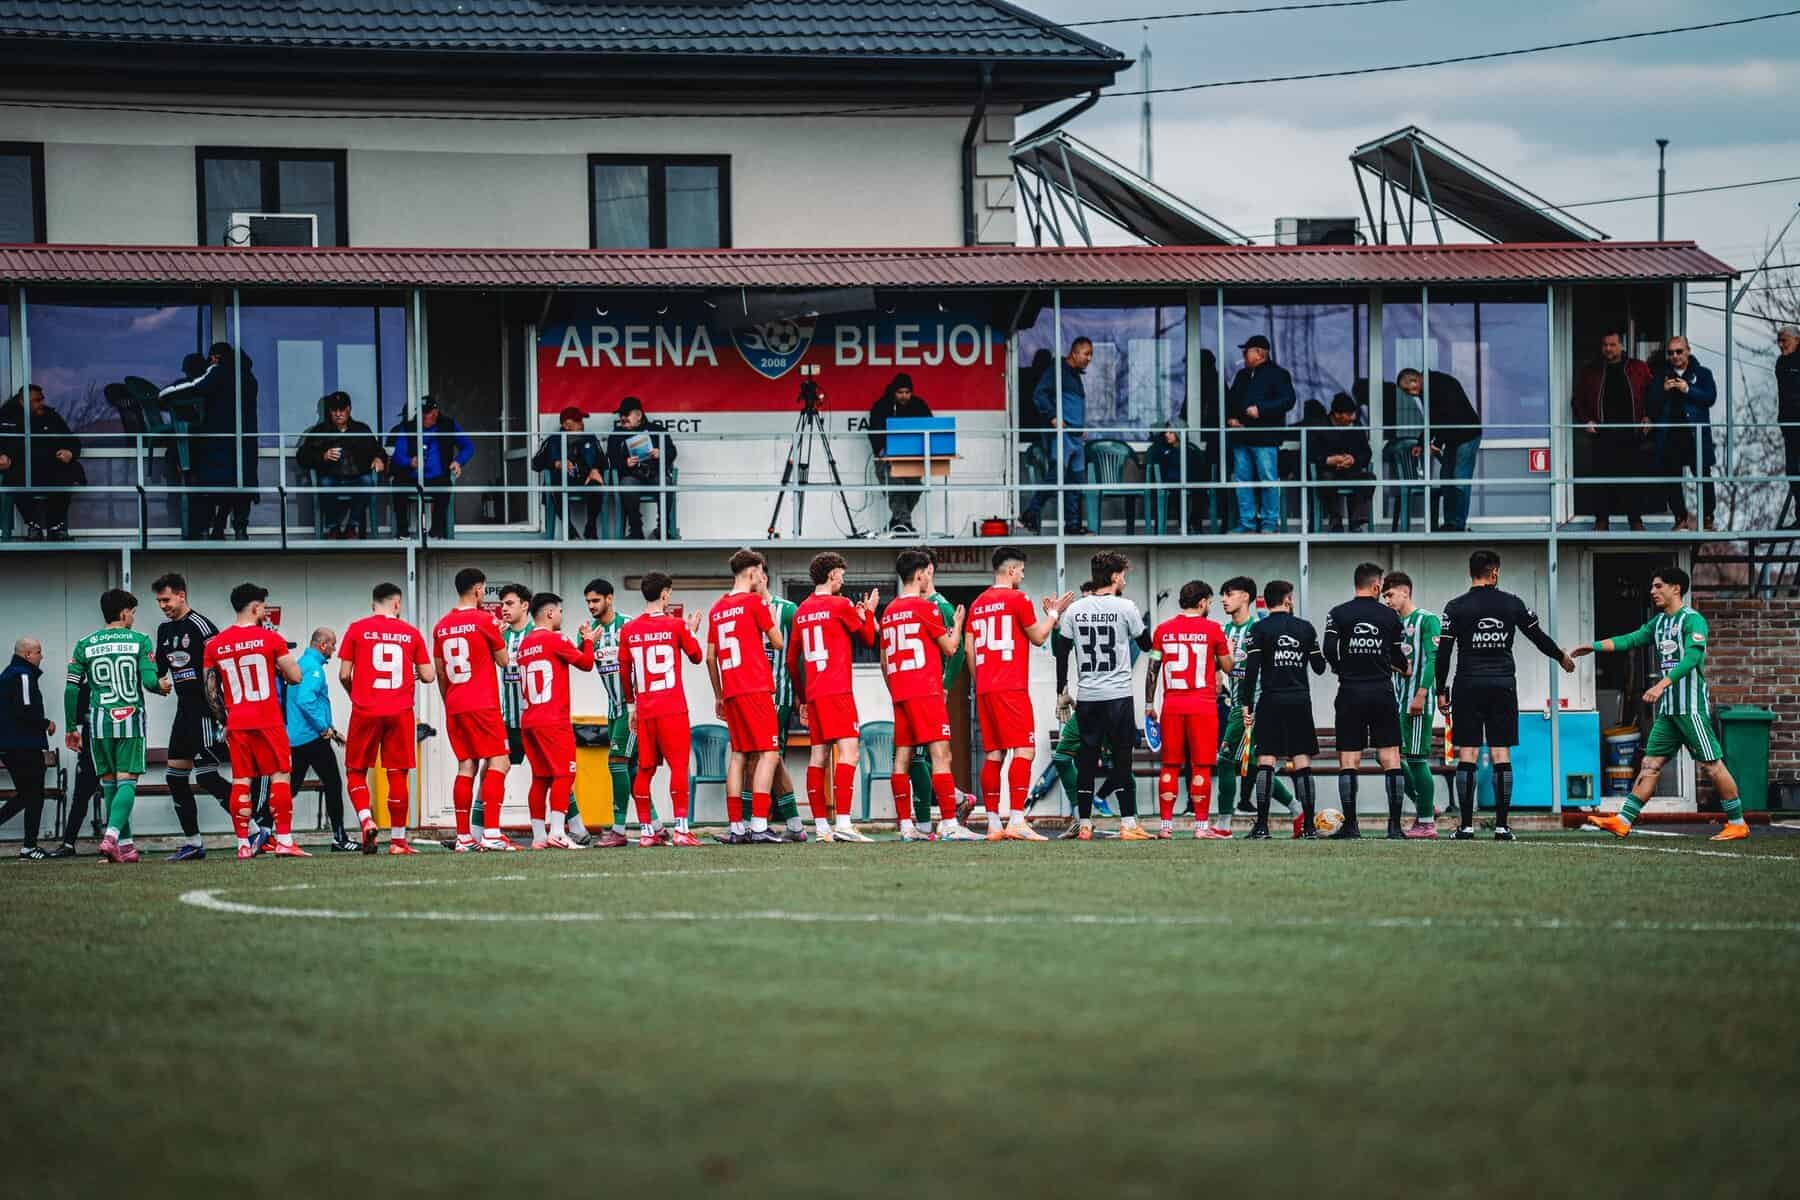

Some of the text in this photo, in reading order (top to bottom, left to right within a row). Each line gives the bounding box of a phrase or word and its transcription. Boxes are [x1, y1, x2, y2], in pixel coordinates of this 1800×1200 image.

[556, 323, 993, 368] ARENA BLEJOI
[760, 357, 787, 368] 2008
[936, 549, 979, 564] BITRI
[450, 623, 476, 634] BLEJOI
[1074, 613, 1118, 624] C.S. BLEJOI
[217, 640, 264, 655] C.S. BLEJOI
[363, 632, 412, 643] C.S. BLEJOI
[629, 632, 672, 642] C.S. BLEJOI
[717, 621, 742, 671] 5
[802, 625, 829, 672] 4
[883, 622, 926, 674] 25
[971, 615, 1015, 667] 24
[1078, 626, 1116, 672] 33
[1178, 634, 1207, 642] BLEJOI
[1349, 638, 1383, 648] MOOV
[1472, 632, 1509, 642] MOOV
[372, 643, 403, 689] 9
[442, 637, 472, 684] 8
[630, 645, 676, 693] 19
[1163, 643, 1208, 689] 21
[1274, 650, 1304, 661] MOOV
[91, 656, 139, 704] 90
[218, 653, 270, 705] 10
[772, 735, 778, 746] 5
